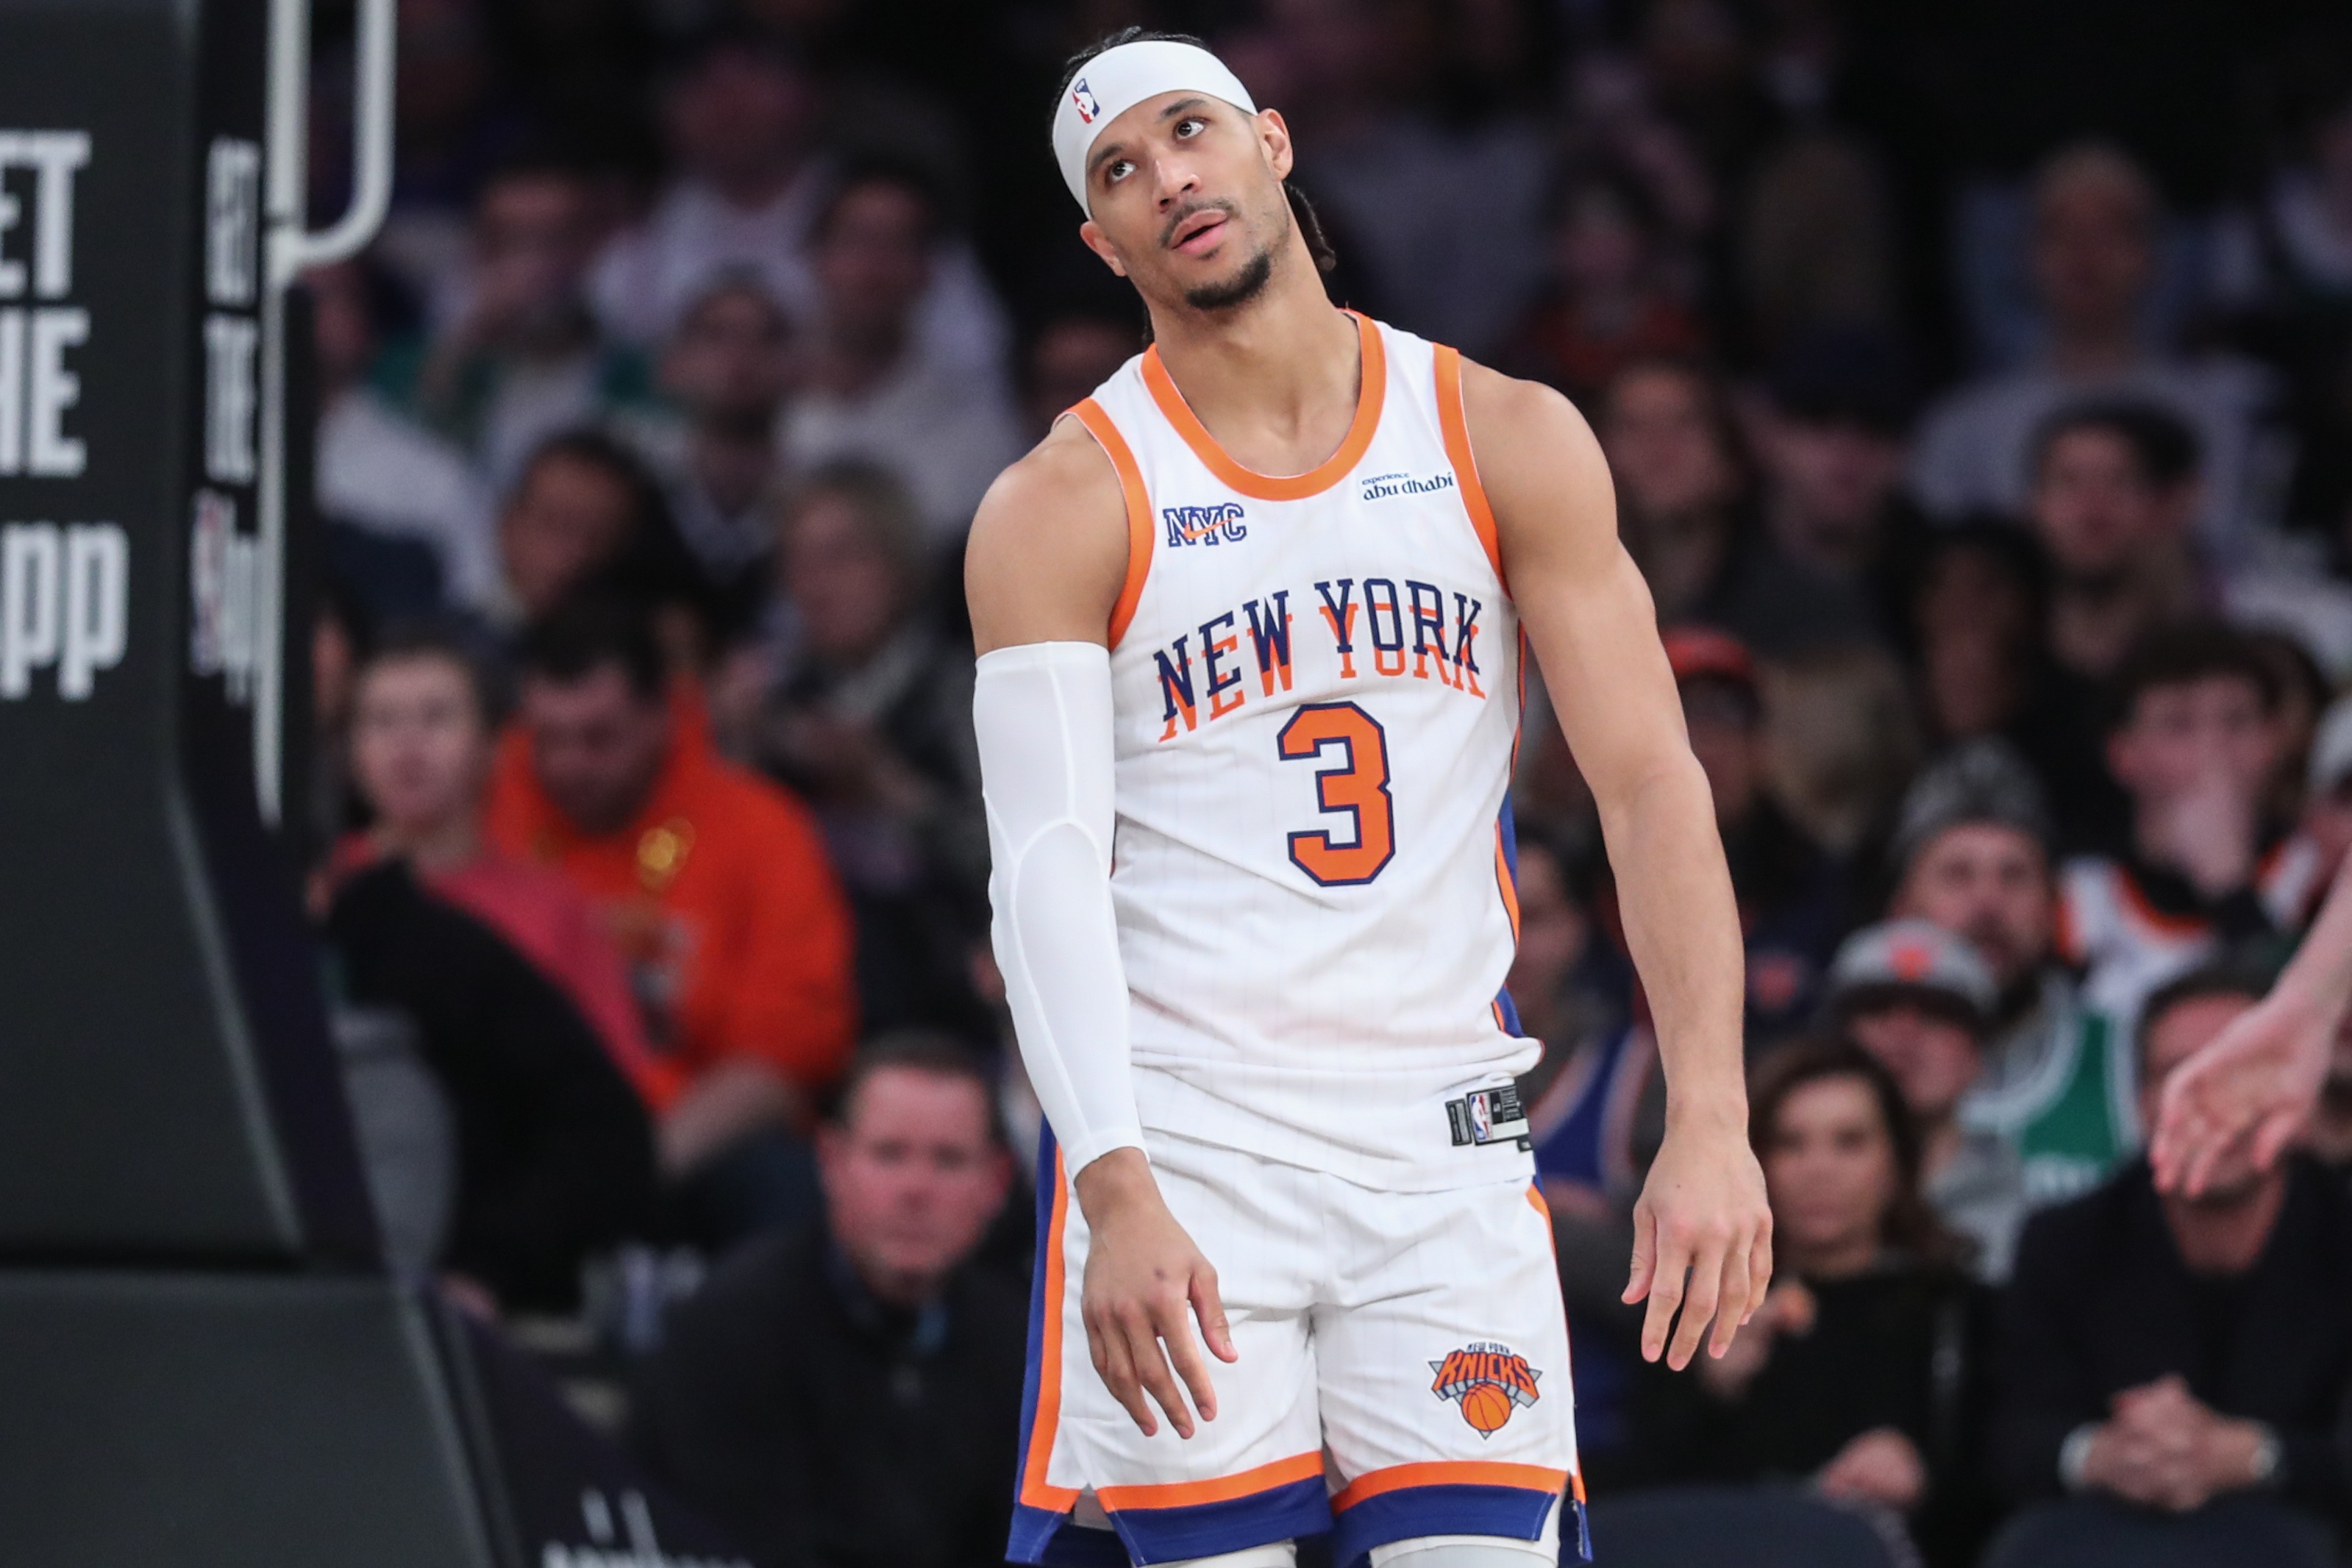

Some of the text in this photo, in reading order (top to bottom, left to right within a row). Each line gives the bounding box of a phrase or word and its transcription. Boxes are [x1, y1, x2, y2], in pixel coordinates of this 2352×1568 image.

[1362, 473, 1409, 485] experience
[1364, 485, 1398, 501] abu
[1163, 502, 1247, 547] NYC
[1153, 578, 1486, 743] NEW YORK
[1276, 701, 1395, 887] 3
[1431, 1349, 1539, 1399] KNICKS
